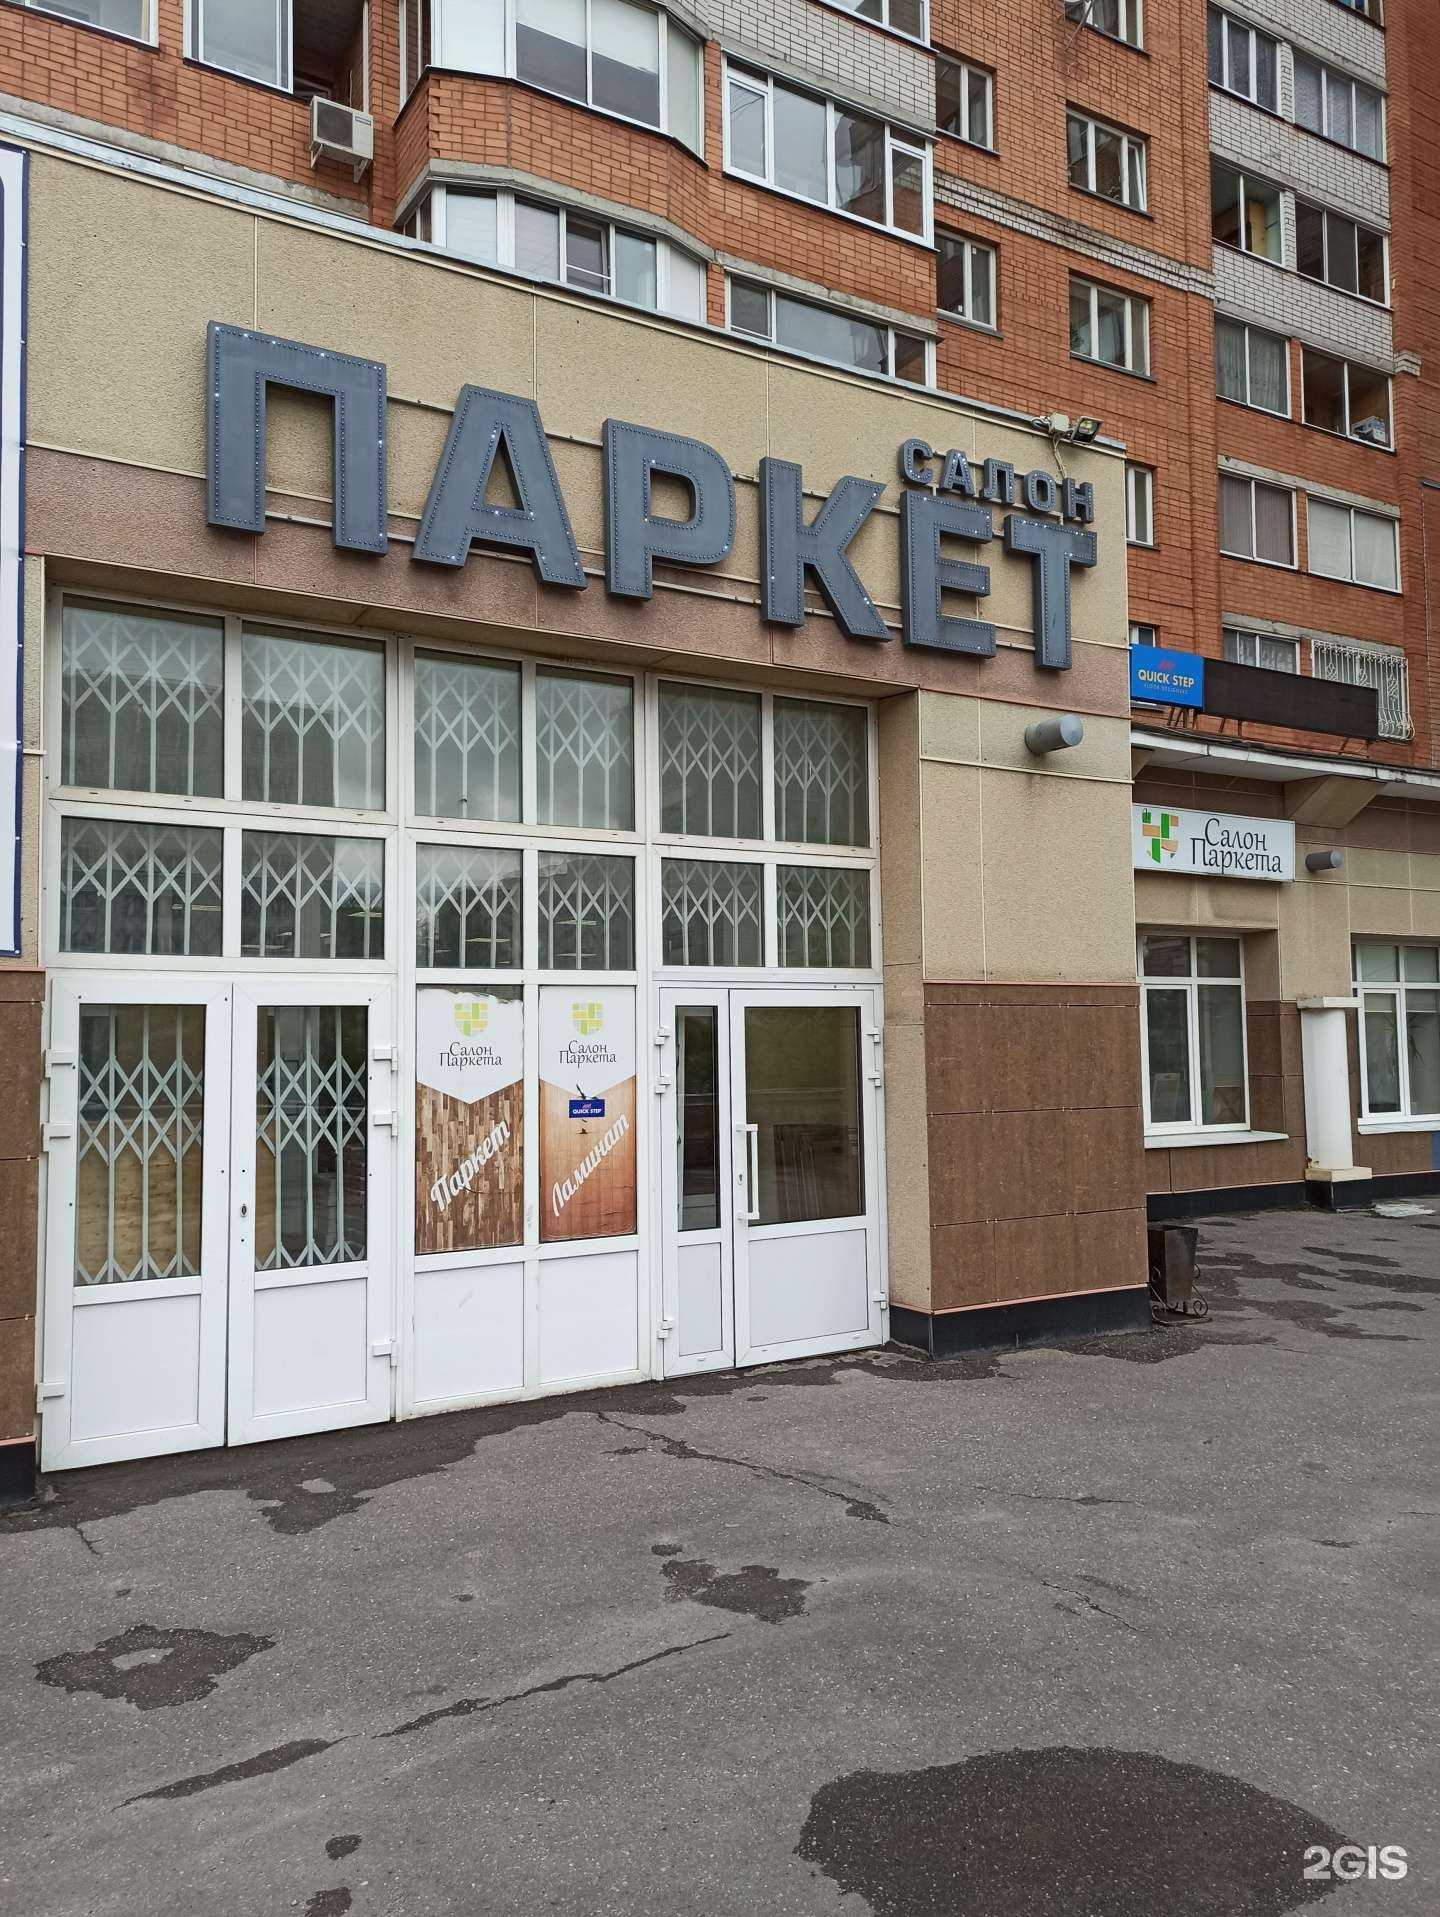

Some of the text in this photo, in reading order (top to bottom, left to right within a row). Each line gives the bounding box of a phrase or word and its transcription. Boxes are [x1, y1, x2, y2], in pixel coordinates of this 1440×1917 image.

[206, 320, 1098, 671] ПАРКЕТ
[901, 438, 1095, 524] САЛОН
[1138, 669, 1195, 688] QUICK STEP
[1204, 818, 1268, 851] Салон
[1190, 837, 1283, 875] Паркета
[440, 1052, 503, 1071] Паркета
[449, 1041, 493, 1056] Салон
[559, 1050, 617, 1068] Паркета
[568, 1039, 608, 1054] Салон
[430, 1120, 511, 1212] Паркет
[551, 1114, 630, 1217] Ламинат
